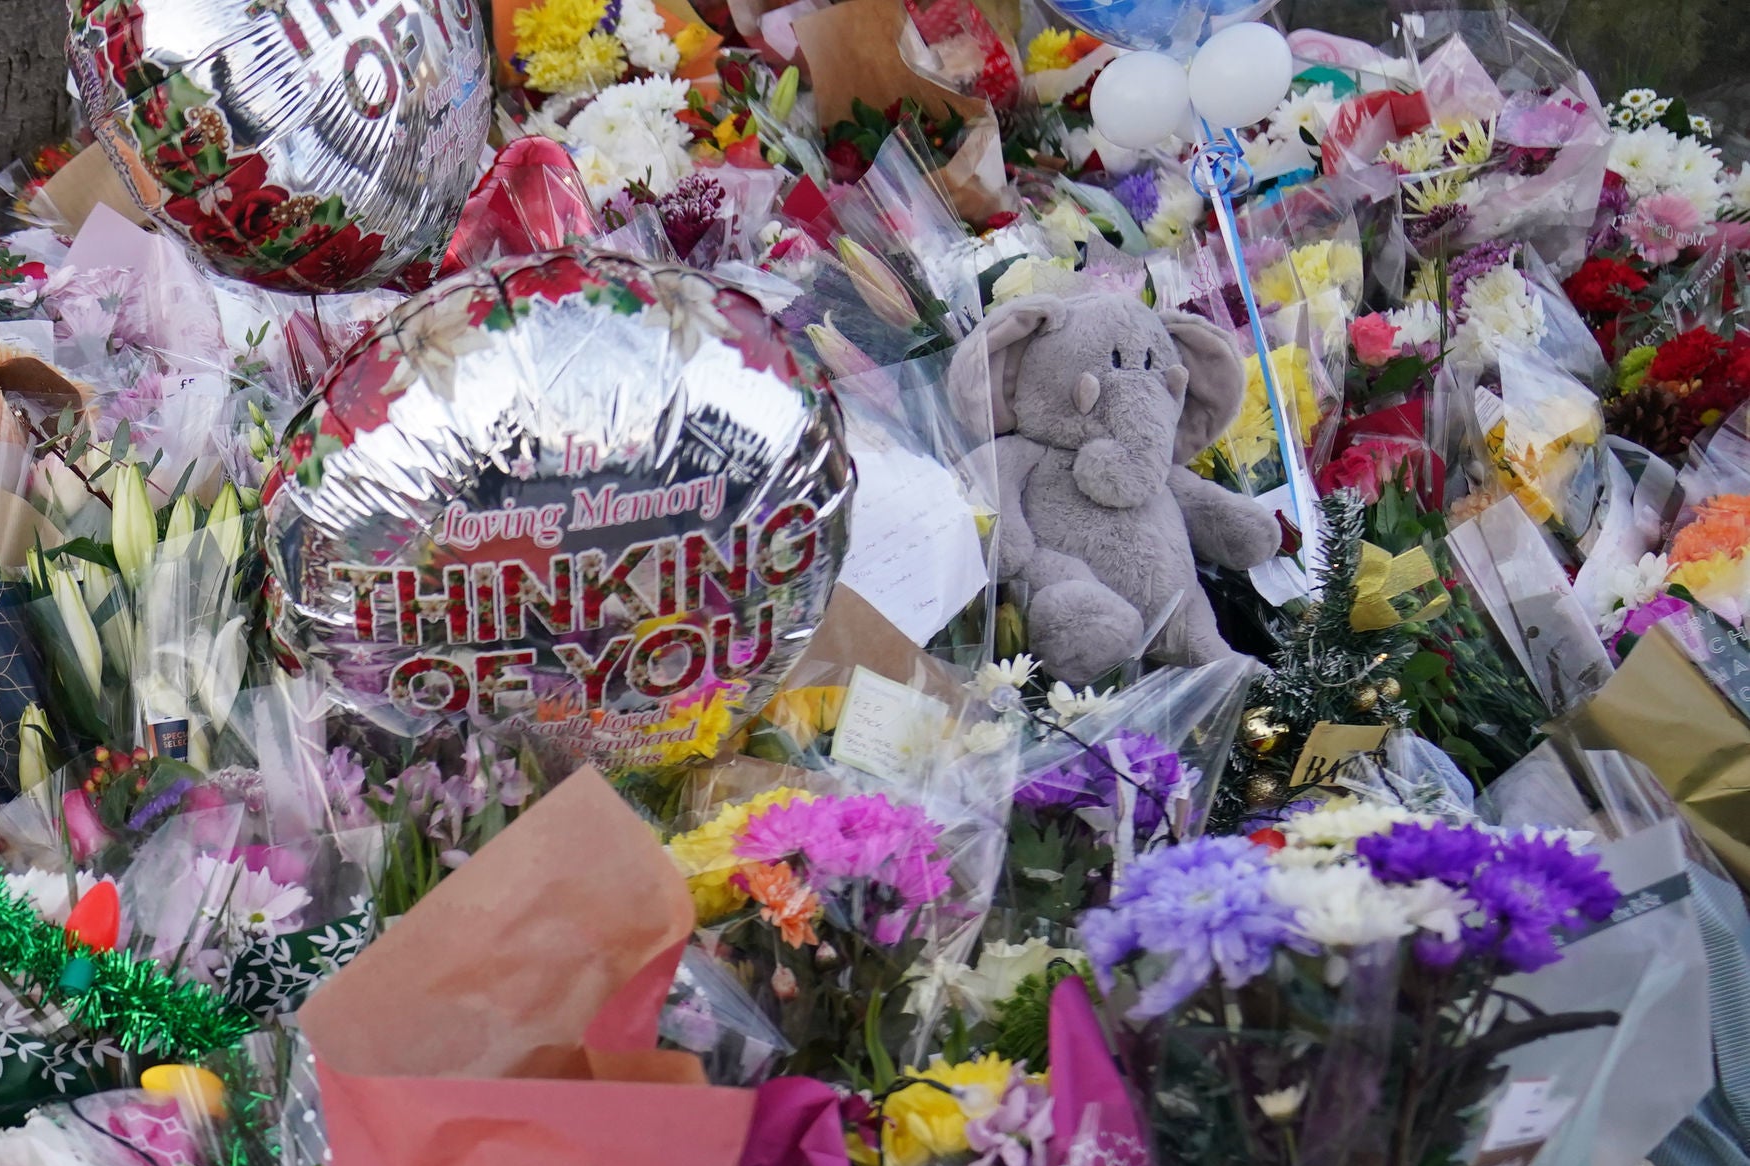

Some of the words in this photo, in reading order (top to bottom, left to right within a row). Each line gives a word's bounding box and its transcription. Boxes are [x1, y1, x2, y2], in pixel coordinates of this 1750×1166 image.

[563, 431, 602, 476] In
[435, 498, 566, 552] Loving
[567, 470, 728, 534] Memory
[328, 499, 821, 648] THINKING
[388, 647, 538, 716] OF
[553, 600, 776, 711] YOU
